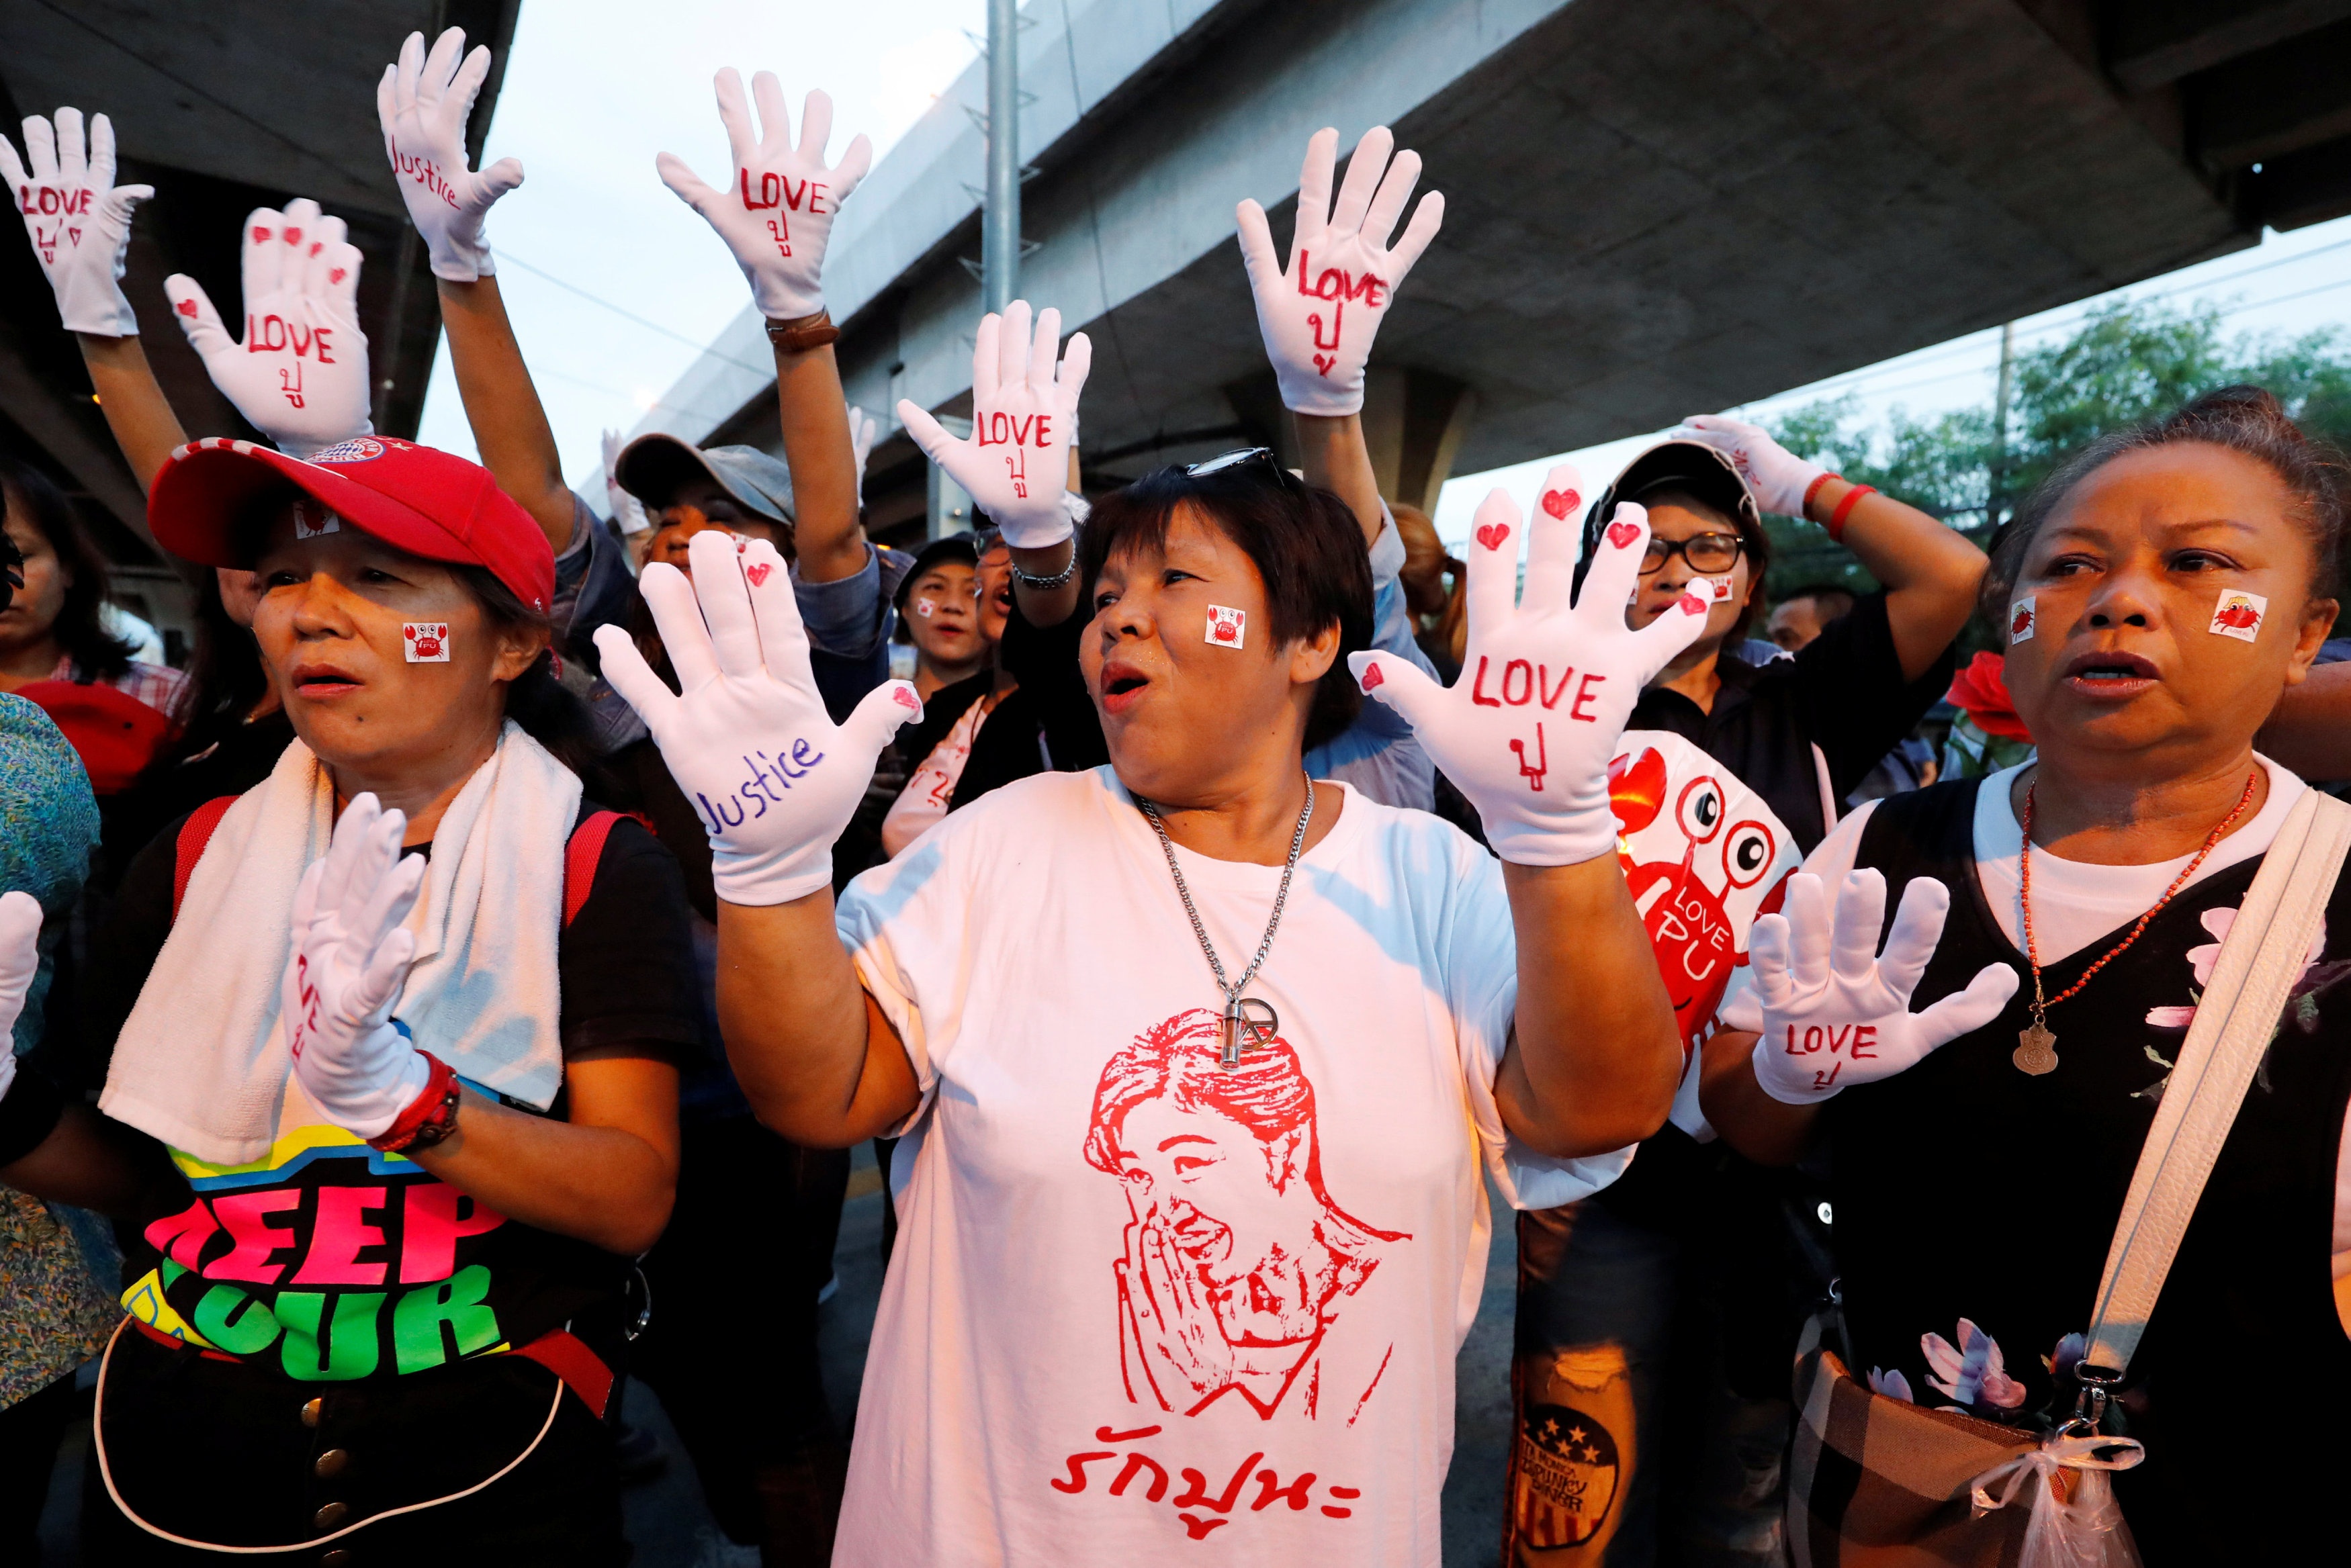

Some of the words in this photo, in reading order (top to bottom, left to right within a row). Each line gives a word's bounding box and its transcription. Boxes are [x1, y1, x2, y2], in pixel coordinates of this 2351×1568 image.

[21, 185, 93, 216] LOVE
[392, 136, 461, 210] Justice
[740, 167, 828, 214] LOVE
[766, 210, 793, 258] ปู
[1297, 248, 1389, 309] LOVE
[248, 314, 336, 364] LOVE
[1306, 298, 1344, 377] ปู
[279, 361, 306, 409] ปู
[977, 411, 1053, 449] LOVE
[1006, 449, 1028, 499] ปู
[1472, 655, 1607, 723] LOVE
[697, 738, 826, 834] Justice
[1656, 909, 1716, 981] PU
[1674, 886, 1730, 952] LOVE
[1785, 1023, 1879, 1059] LOVE
[1050, 1424, 1362, 1541] รักปูนะ
